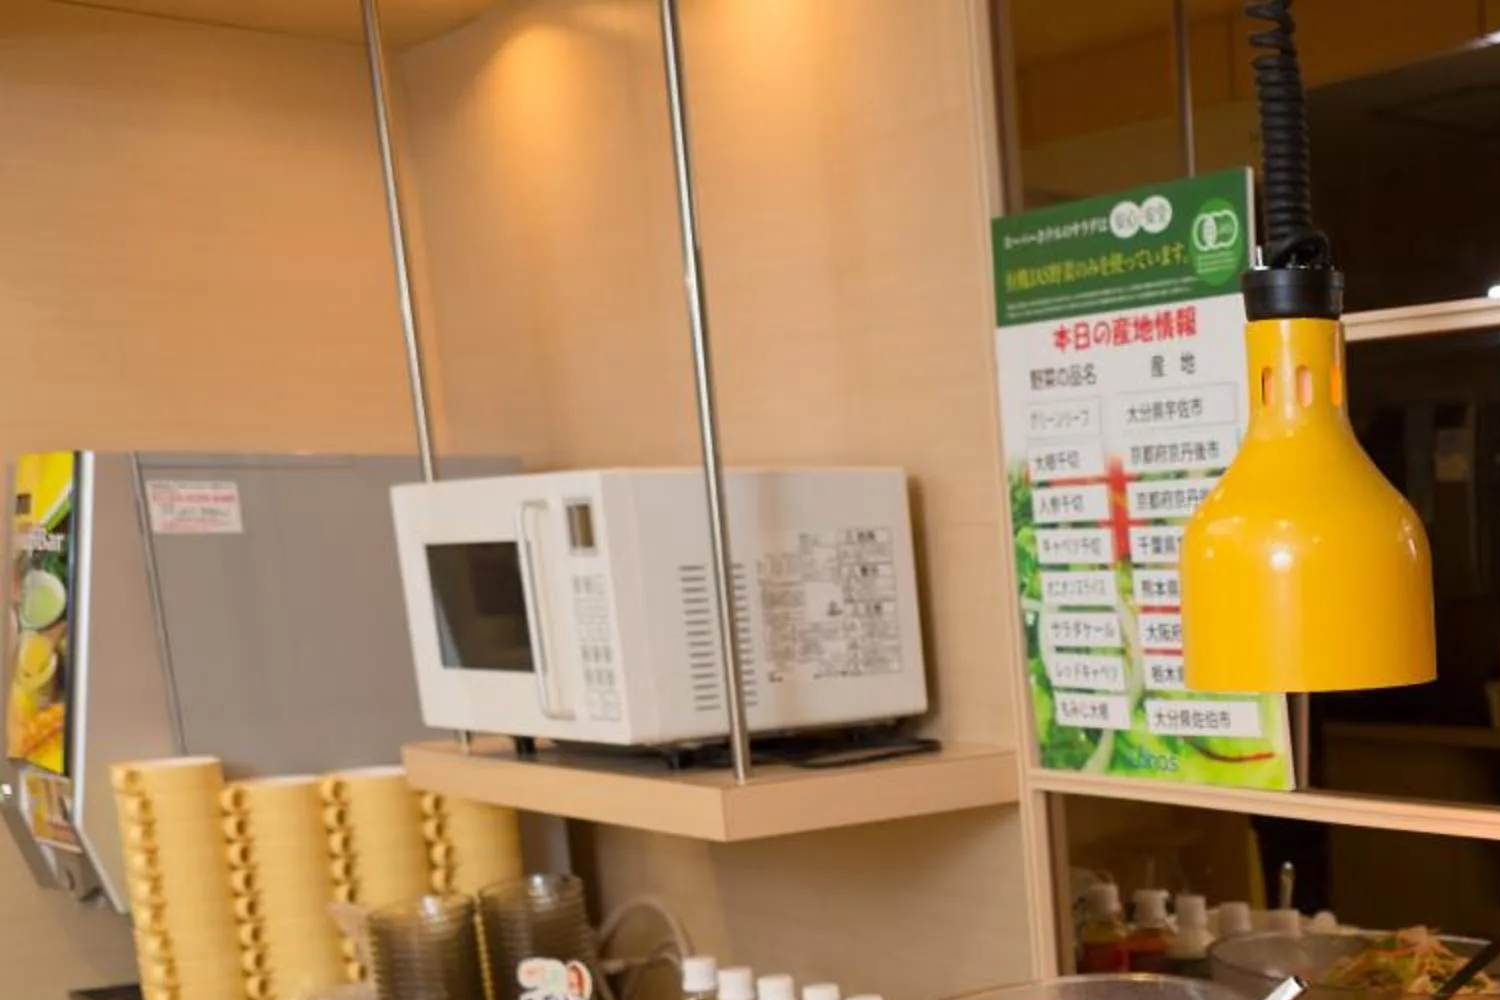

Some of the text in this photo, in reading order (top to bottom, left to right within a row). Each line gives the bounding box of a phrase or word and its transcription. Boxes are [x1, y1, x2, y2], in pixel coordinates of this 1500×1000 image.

[1053, 305, 1197, 352] 本日の産地情報
[1030, 363, 1097, 390] 野菜の品名
[1126, 398, 1203, 424] 大分県宇佐市
[1136, 487, 1209, 511] 京都府京丹
[1137, 534, 1183, 555] 千葉県
[1154, 709, 1232, 730] 大分県佐伯市
